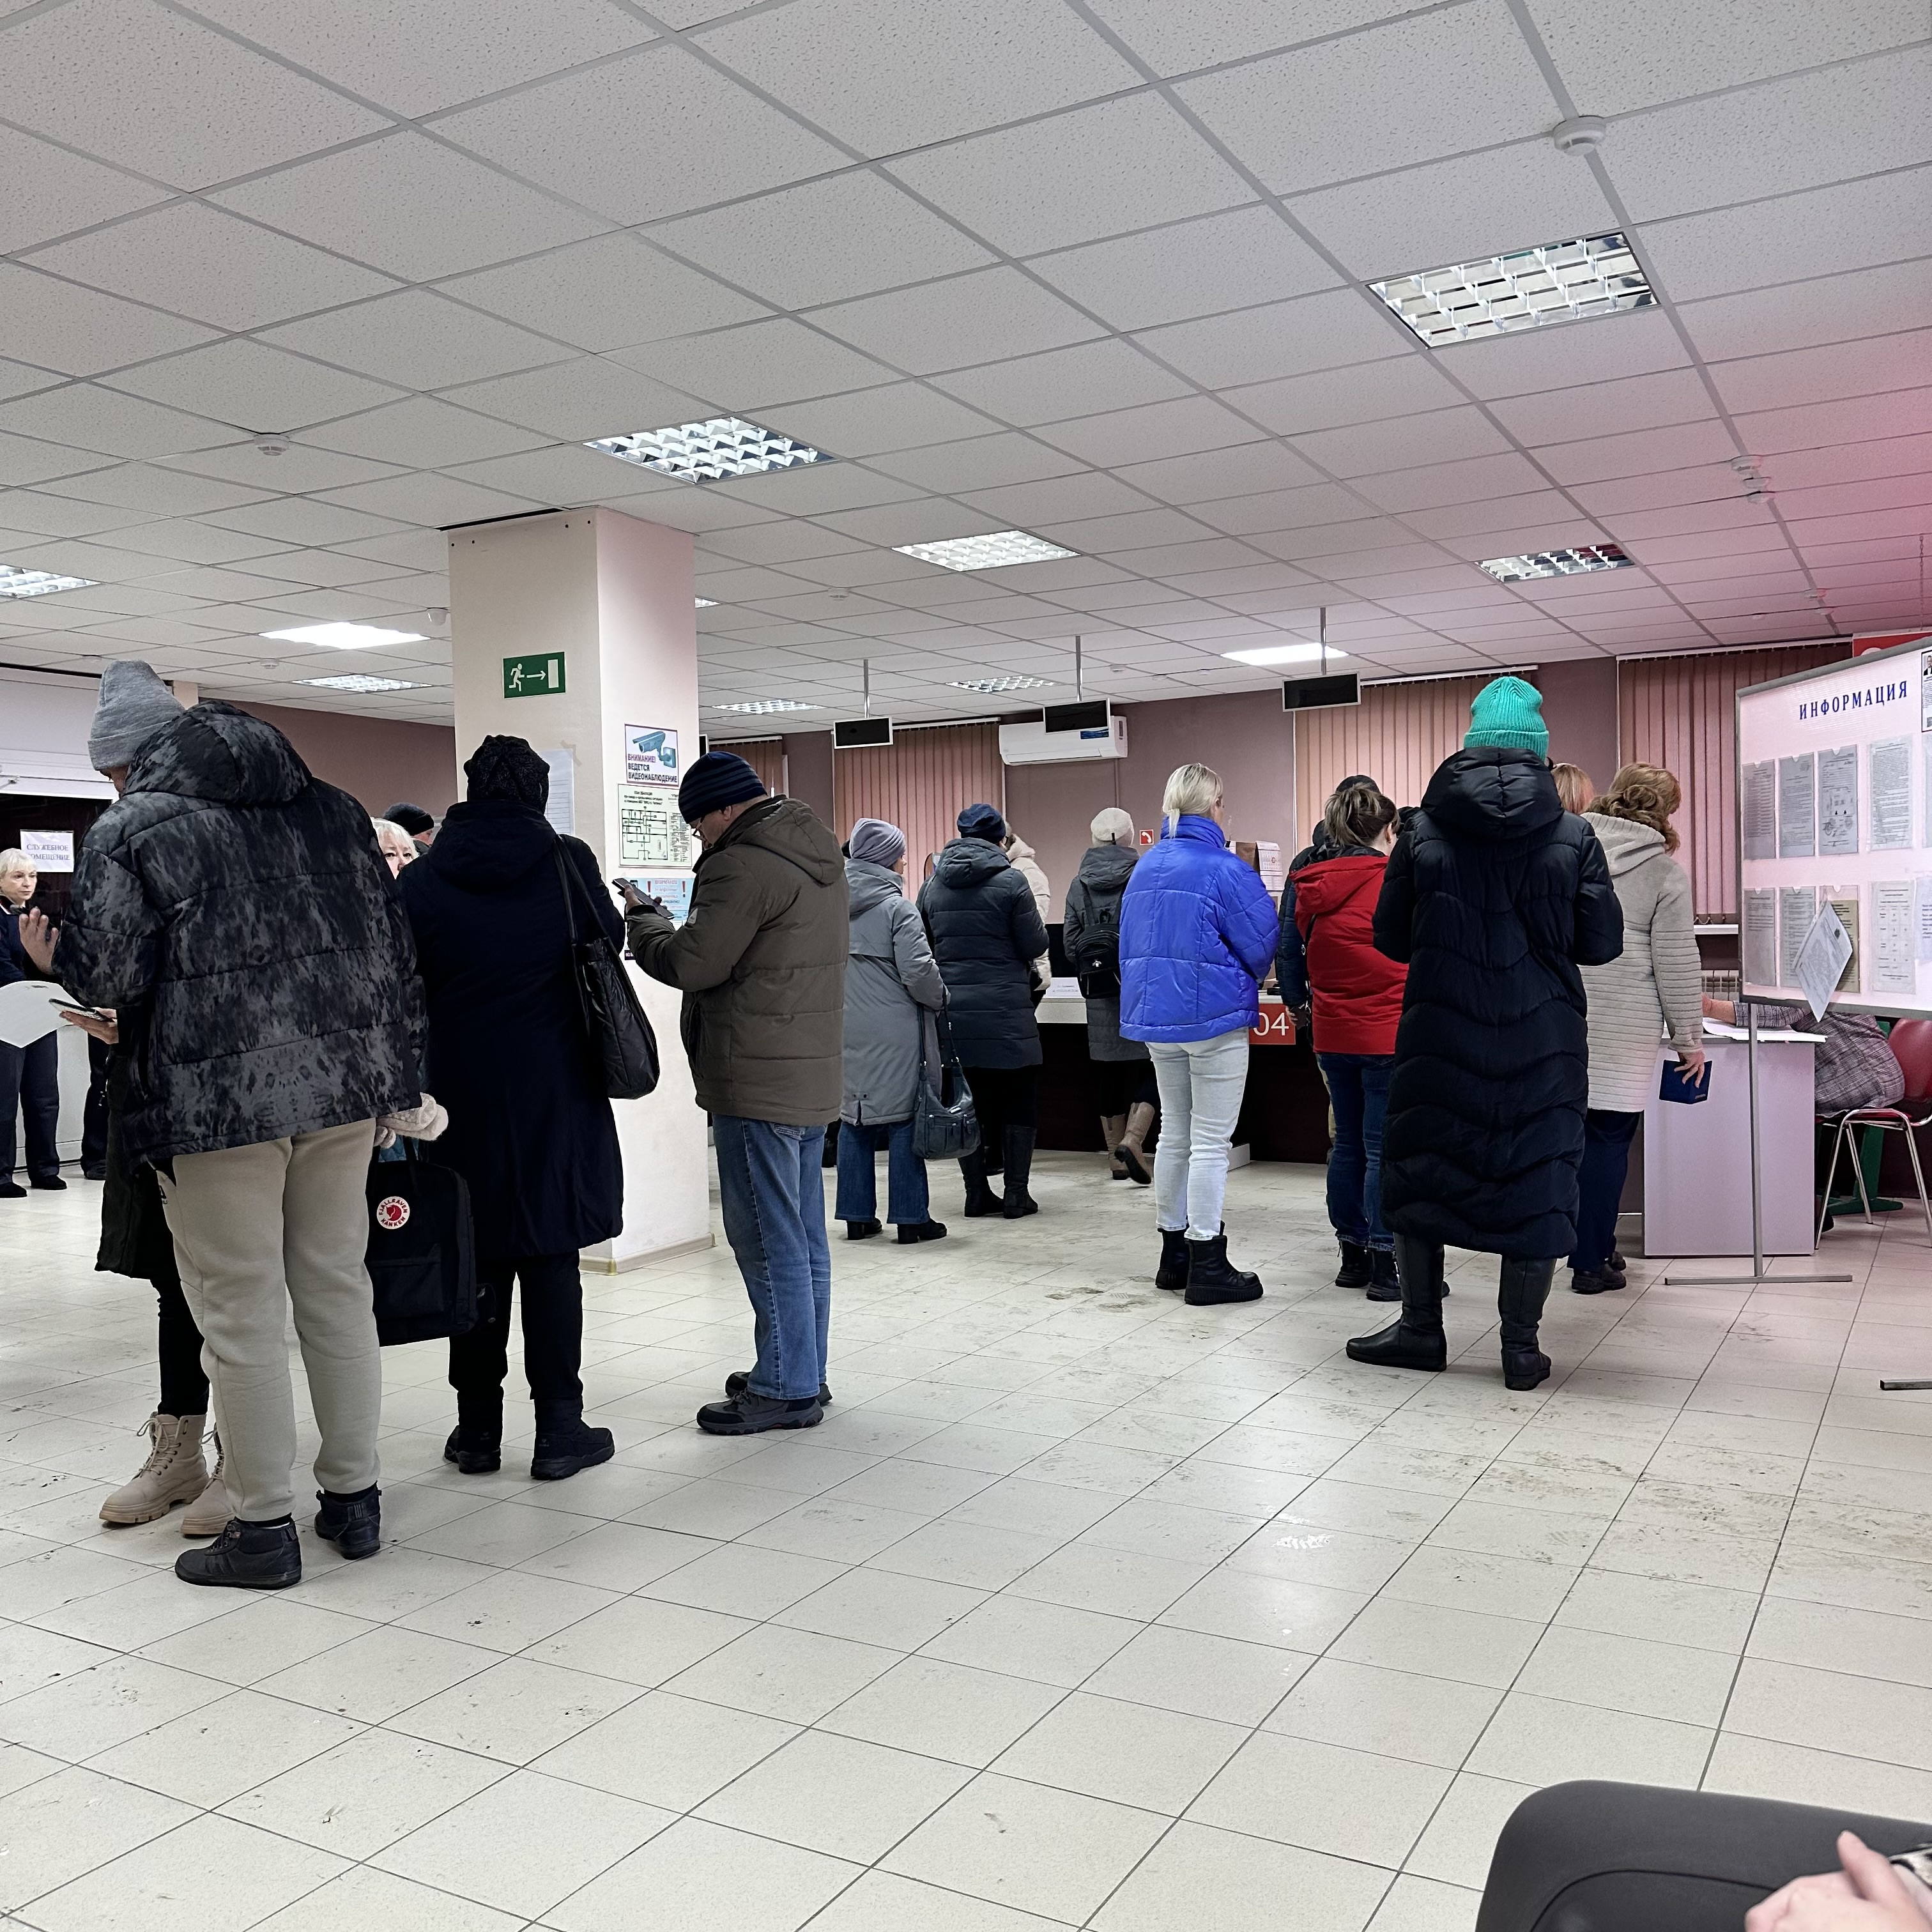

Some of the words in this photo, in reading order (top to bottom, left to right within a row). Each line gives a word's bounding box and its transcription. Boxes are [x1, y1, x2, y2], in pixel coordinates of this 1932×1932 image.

[1799, 680, 1908, 720] ИНФОРМАЦИЯ
[627, 753, 656, 763] ВНИМАНИЕ!
[628, 763, 650, 772] ВЕДЕТСЯ
[628, 772, 677, 783] ВИДЕОНАБЛЮДЕНИЕ
[1253, 1012, 1289, 1036] 04
